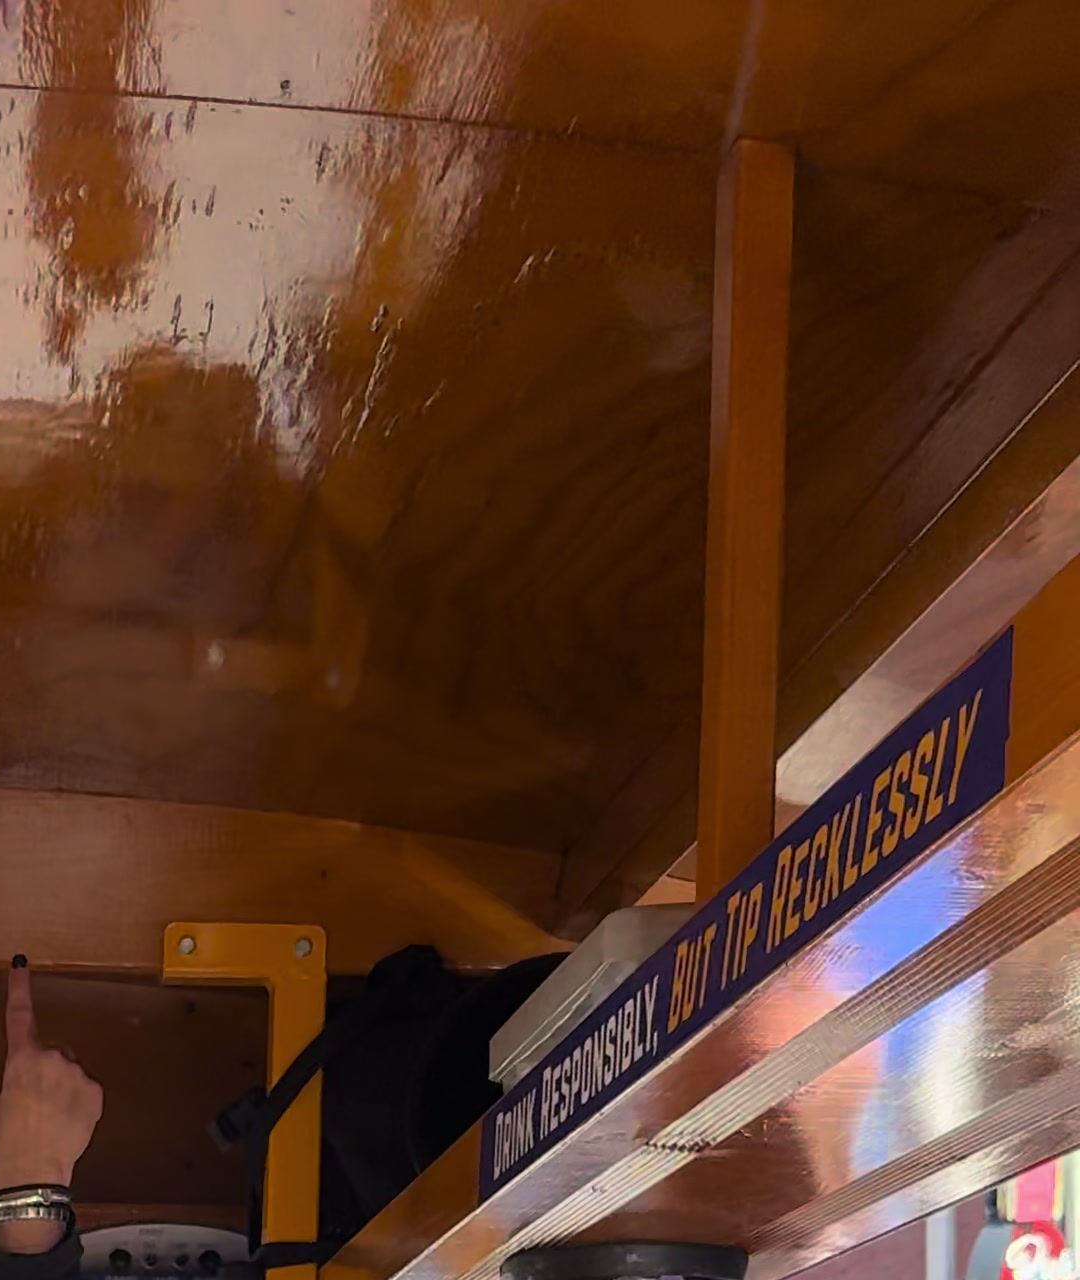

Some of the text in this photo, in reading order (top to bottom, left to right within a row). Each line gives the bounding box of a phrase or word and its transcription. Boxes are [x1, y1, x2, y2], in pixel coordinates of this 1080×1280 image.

[493, 688, 983, 1181] DRINK RESPONSIBLY, BUT TIP RECKLESSLY
